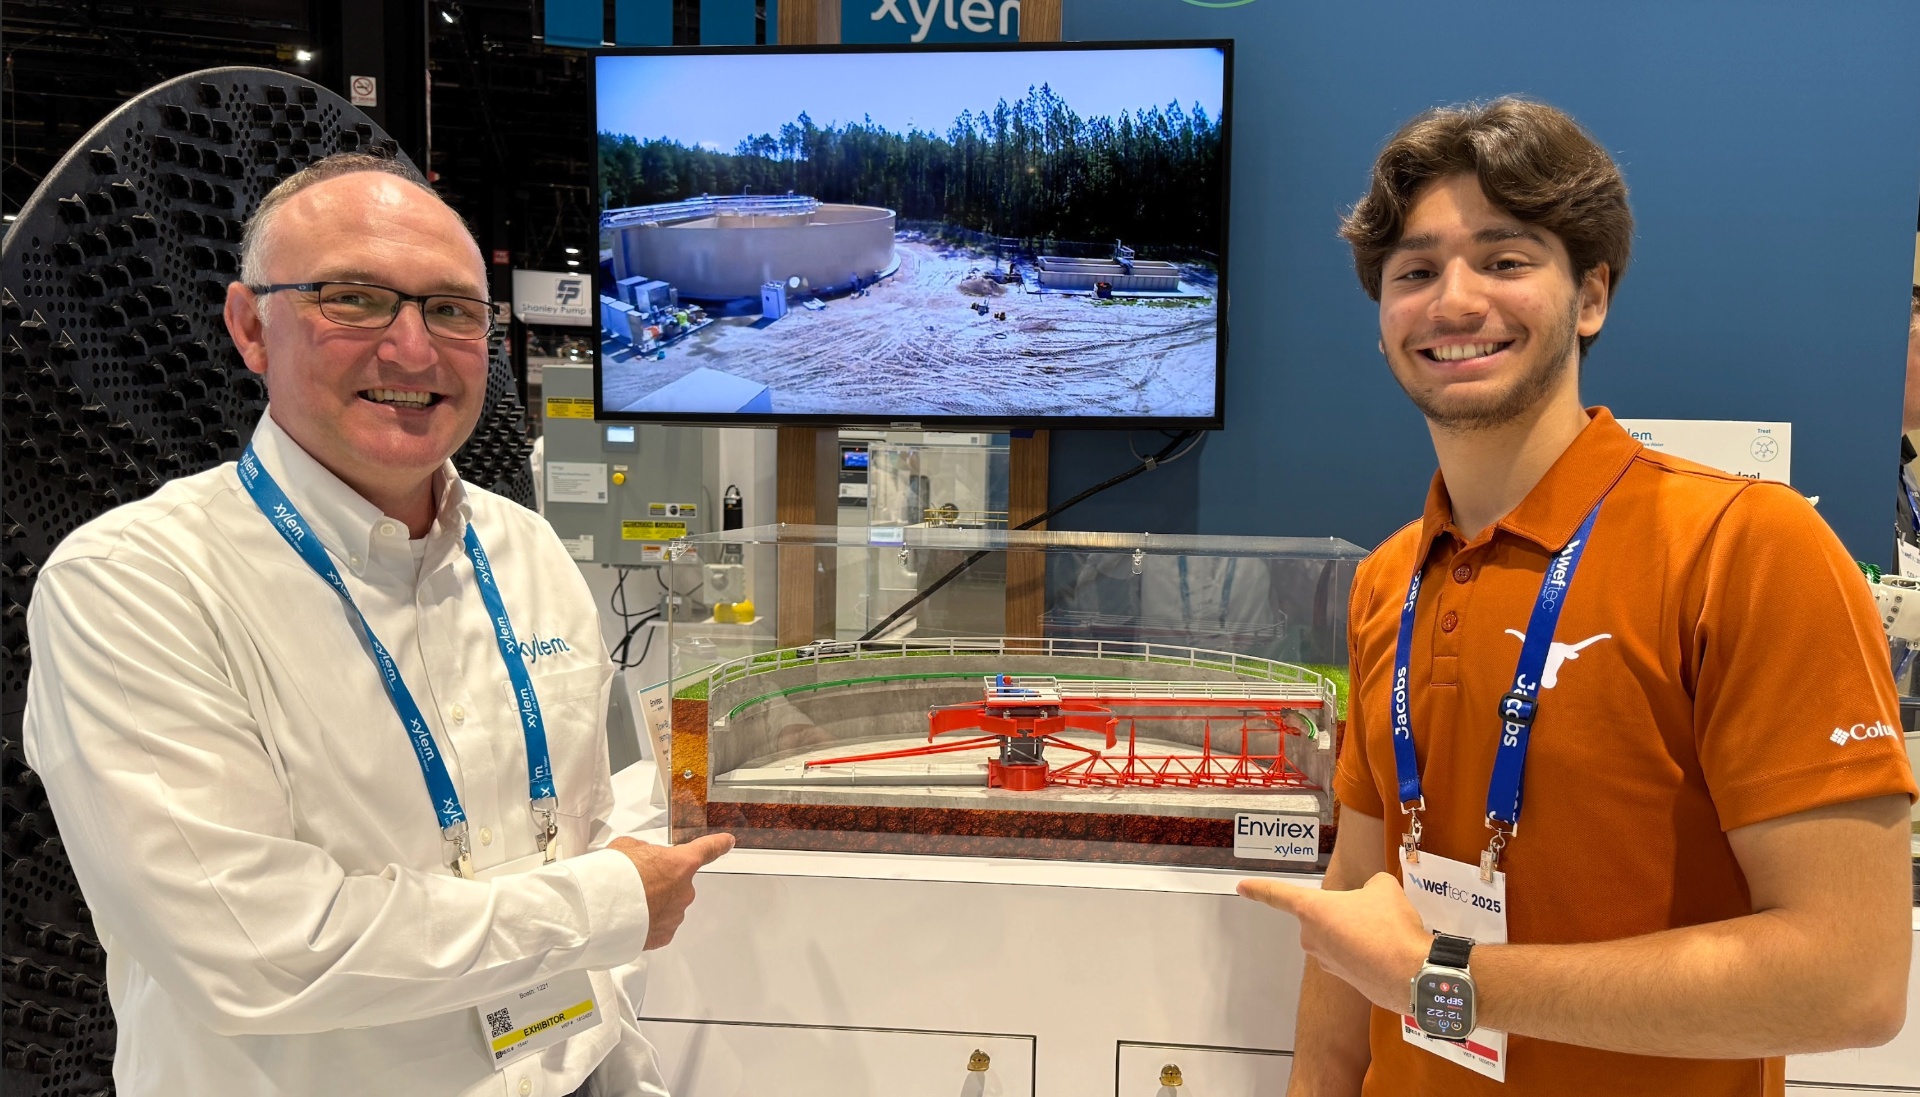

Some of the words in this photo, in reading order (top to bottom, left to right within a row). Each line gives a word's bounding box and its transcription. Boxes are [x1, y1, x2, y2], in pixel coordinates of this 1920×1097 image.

[522, 303, 558, 314] Shanley
[560, 306, 587, 315] Pump
[1627, 428, 1653, 441] lem
[240, 452, 259, 480] xylem
[273, 503, 305, 541] xylem
[472, 548, 491, 585] xylem
[1404, 570, 1421, 612] Jaco
[1542, 556, 1572, 610] weftec
[497, 617, 515, 654] xylem
[373, 640, 396, 682] xylem
[520, 688, 538, 728] xylem
[1393, 666, 1409, 740] Jacobs
[410, 718, 434, 761] xylem
[443, 797, 462, 826] xyle
[1238, 816, 1315, 839] Envirex
[1274, 843, 1315, 857] xylem
[1422, 879, 1469, 903] weftec
[1471, 893, 1501, 913] 2025
[519, 988, 536, 999] Booth:
[536, 983, 549, 992] 1221
[1434, 995, 1446, 1003] 30
[1447, 997, 1464, 1006] SEP
[523, 1013, 566, 1037] EXHIBITOR
[1427, 1008, 1462, 1020] 12:22
